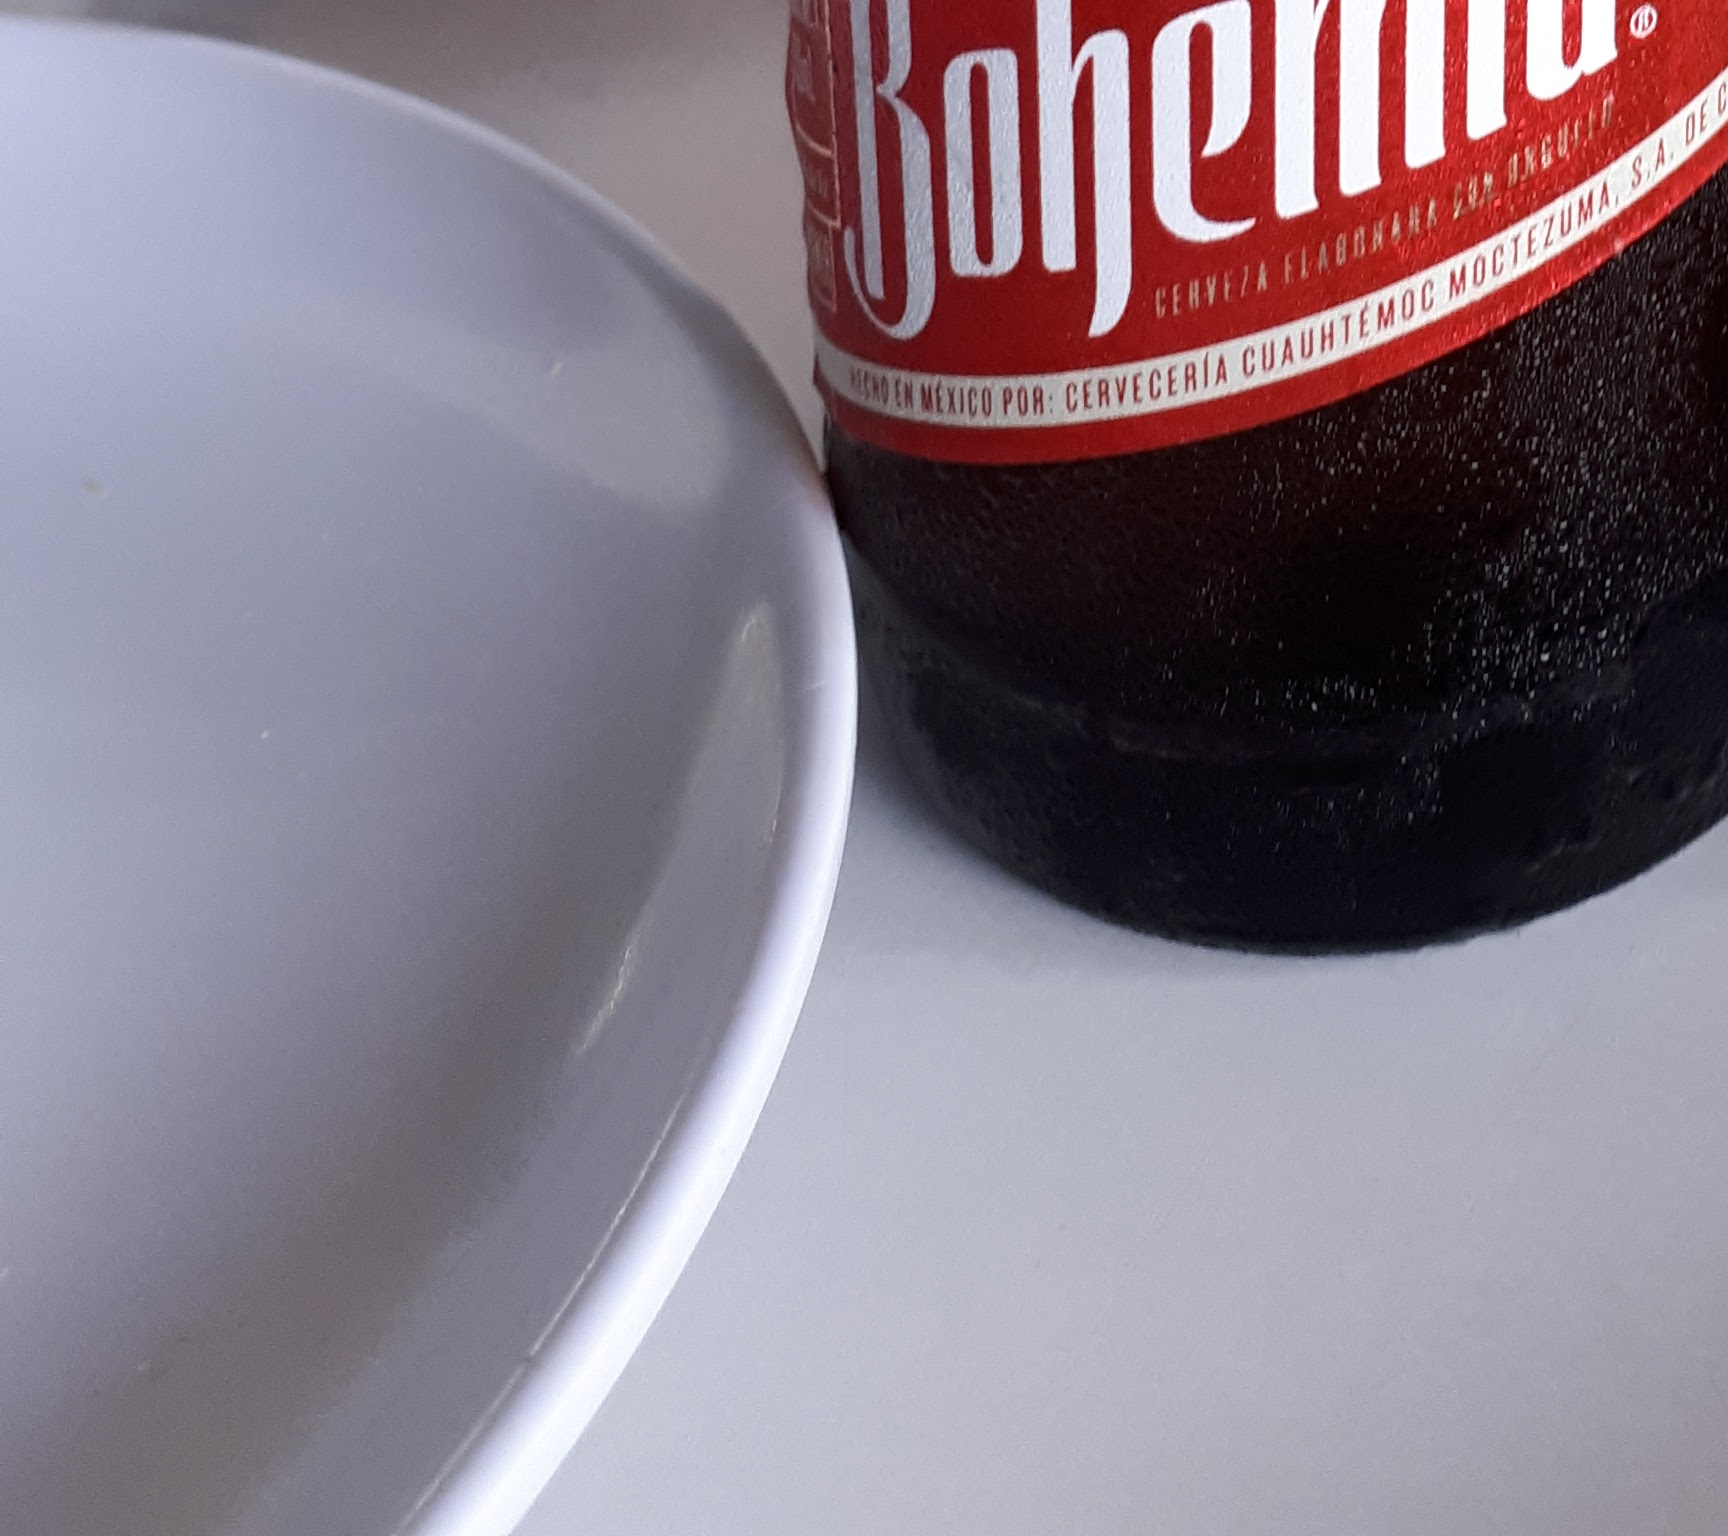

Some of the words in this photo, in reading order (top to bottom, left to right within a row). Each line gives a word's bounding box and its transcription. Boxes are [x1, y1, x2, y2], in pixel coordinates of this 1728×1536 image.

[895, 373, 914, 410] EN
[919, 374, 993, 418] MÉXICO
[1002, 385, 1055, 417] POR:
[1064, 350, 1229, 416] CERVECERÍA
[1241, 278, 1437, 378] CUAUHTÉMOC
[1447, 176, 1621, 302] MOCTEZUMA,
[1630, 136, 1675, 191] S.A.
[1684, 105, 1709, 148] DE
[1153, 260, 1269, 319] CERVEZA
[1283, 196, 1439, 286] ELABORADA
